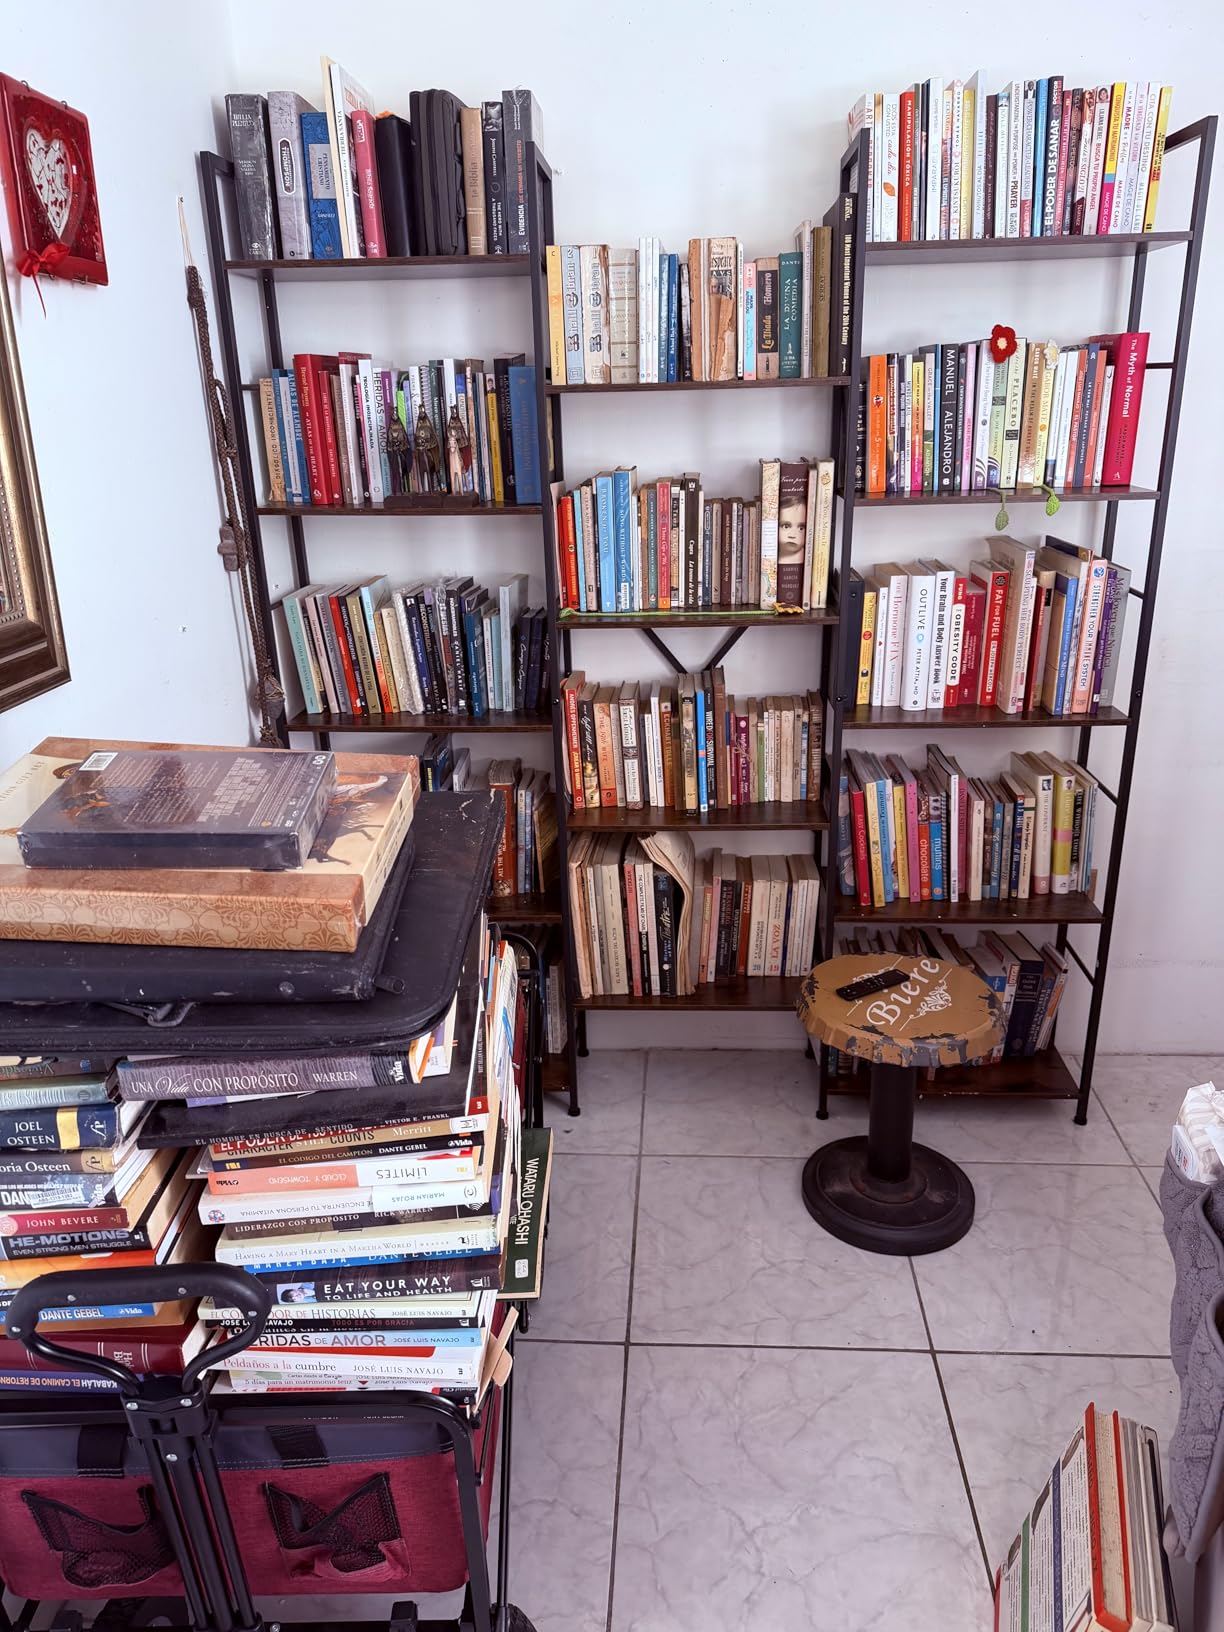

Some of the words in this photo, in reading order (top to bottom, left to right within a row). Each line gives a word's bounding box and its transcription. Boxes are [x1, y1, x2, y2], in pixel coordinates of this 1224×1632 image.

[1124, 107, 1132, 130] MADRE
[1049, 120, 1060, 159] SANAR
[281, 146, 291, 187] THOMPSON
[1049, 160, 1057, 172] DE
[1010, 180, 1018, 208] PRAYER
[1046, 176, 1056, 216] PODER
[1045, 216, 1054, 225] EL
[945, 349, 954, 396] MANUEL
[1127, 352, 1138, 376] Myth
[288, 374, 296, 396] ALMAS
[373, 372, 384, 414] HERIDAS
[1011, 378, 1019, 427] PLACEBO
[1122, 384, 1133, 418] Normal
[378, 425, 387, 455] AMOR
[942, 410, 952, 474] ALEJANDRO
[940, 578, 949, 592] Your
[938, 594, 947, 612] Brain
[995, 590, 1003, 605] FAT
[1090, 585, 1101, 618] STRENGTHEN
[891, 596, 902, 639] Hormone
[917, 589, 928, 630] OUTLIVE
[937, 614, 945, 626] and
[991, 617, 1000, 637] FUEL
[1087, 620, 1095, 638] YOUR
[935, 627, 944, 643] Body
[952, 614, 962, 653] OBESITY
[934, 645, 943, 666] Answer
[1104, 639, 1116, 668] Nunca
[933, 668, 941, 684] Book
[950, 656, 958, 680] CODE
[1080, 664, 1088, 687] SYSTEM
[663, 713, 671, 745] ECKHART
[920, 839, 929, 882] chocolate
[934, 838, 942, 870] muffins
[772, 924, 780, 943] VOZ
[771, 946, 778, 959] LA
[131, 1081, 154, 1094] UNA
[155, 1073, 192, 1095] Vida
[193, 1077, 223, 1093] CON
[225, 1070, 299, 1091] PROPÓSITO
[312, 1070, 358, 1084] WARREN
[15, 1120, 43, 1134] JOEL
[209, 1134, 246, 1144] HOMBRE
[249, 1131, 261, 1139] EN
[263, 1130, 292, 1139] BUSCA
[315, 1123, 354, 1134] SENTIDO
[385, 1116, 411, 1125] VIKTOR
[423, 1112, 450, 1121] FRANKL
[393, 1125, 433, 1138] Merritt
[7, 1134, 55, 1147] OSTEEN
[454, 1139, 474, 1148] Vida
[322, 1152, 336, 1160] DEL
[379, 1146, 405, 1155] DANTE
[405, 1143, 428, 1152] GEBEL
[25, 1160, 71, 1173] Osteen
[269, 1175, 312, 1185] TOWNSEND
[322, 1172, 348, 1182] CLOUD
[521, 1157, 540, 1198] WATARU
[391, 1193, 415, 1203] ROJAS
[416, 1190, 445, 1201] MARIAN
[240, 1208, 276, 1219] VITAMINA
[277, 1206, 309, 1216] PERSONA
[311, 1205, 321, 1213] TU
[322, 1199, 365, 1211] ENCUENTRA
[26, 1218, 57, 1230] JOHN
[61, 1215, 100, 1226] BEVERE
[234, 1221, 285, 1234] LIDERAZGO
[288, 1218, 308, 1228] CON
[374, 1211, 396, 1220] RICK
[514, 1200, 533, 1245] OHASHI
[10, 1229, 131, 1248] HE-MOTIONS
[12, 1247, 36, 1256] EVEN
[36, 1245, 70, 1255] STRONG
[70, 1243, 90, 1252] MEN
[91, 1240, 133, 1250] STRUGGLE
[324, 1283, 355, 1294] EAT
[361, 1278, 409, 1292] YOUR
[414, 1275, 451, 1287] WAY
[346, 1291, 372, 1299] LIFE
[376, 1289, 402, 1298] AND
[406, 1286, 453, 1296] HEALTH
[41, 1309, 73, 1321] DANTE
[74, 1307, 104, 1319] GEBEL
[311, 1308, 376, 1319] HISTORIAS
[315, 1337, 328, 1345] DE
[331, 1334, 387, 1346] AMOR
[223, 1356, 270, 1370] Peldaños
[283, 1360, 294, 1370] la
[295, 1359, 337, 1372] cumbre
[380, 1365, 402, 1373] LUIS
[406, 1366, 444, 1375] NAVAJO
[31, 1377, 40, 1385] DE
[42, 1378, 70, 1386] CAMINO
[71, 1378, 80, 1386] EL
